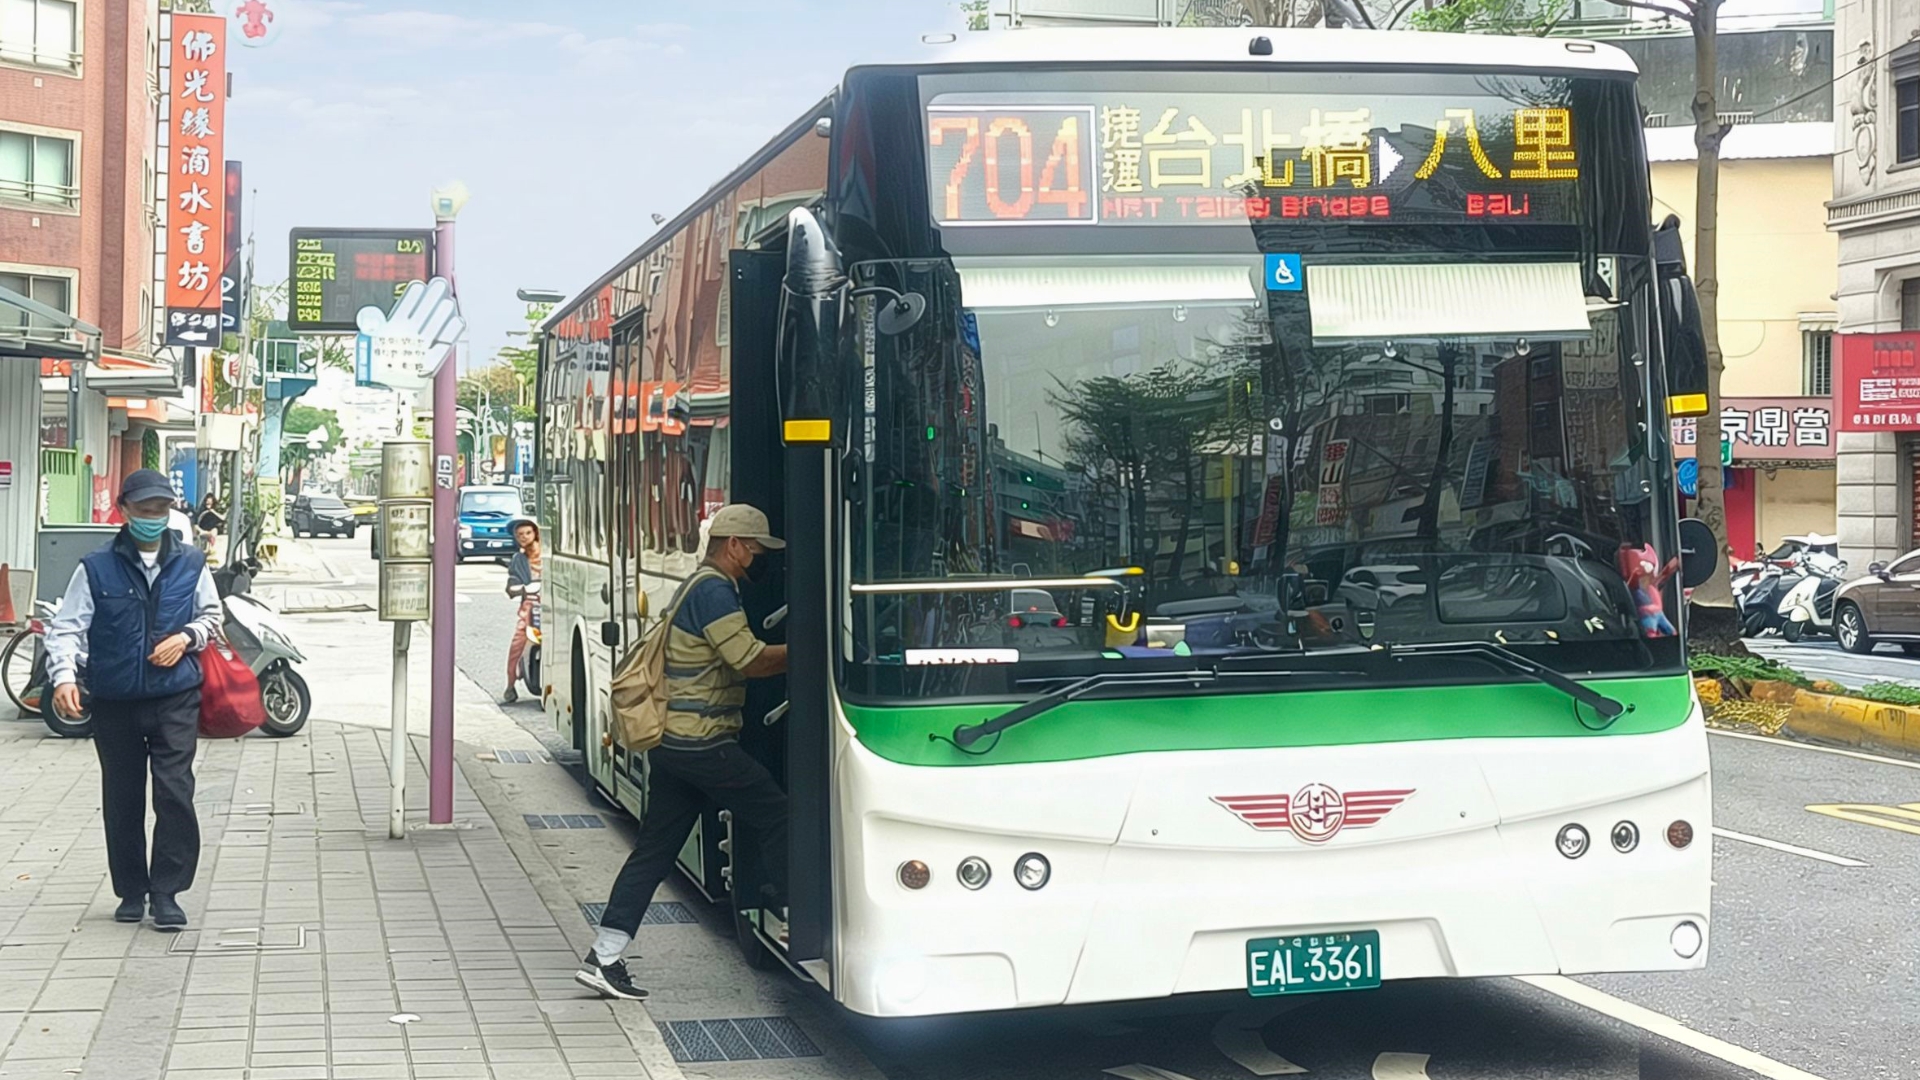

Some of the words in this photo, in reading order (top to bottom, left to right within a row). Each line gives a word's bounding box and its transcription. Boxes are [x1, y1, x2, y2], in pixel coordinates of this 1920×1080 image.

[930, 116, 1088, 220] 704
[1101, 104, 1144, 193] 捷運
[1143, 107, 1373, 189] 台北橋
[1414, 107, 1579, 180] 八里
[1102, 196, 1165, 219] MRT
[1467, 193, 1530, 216] Bali
